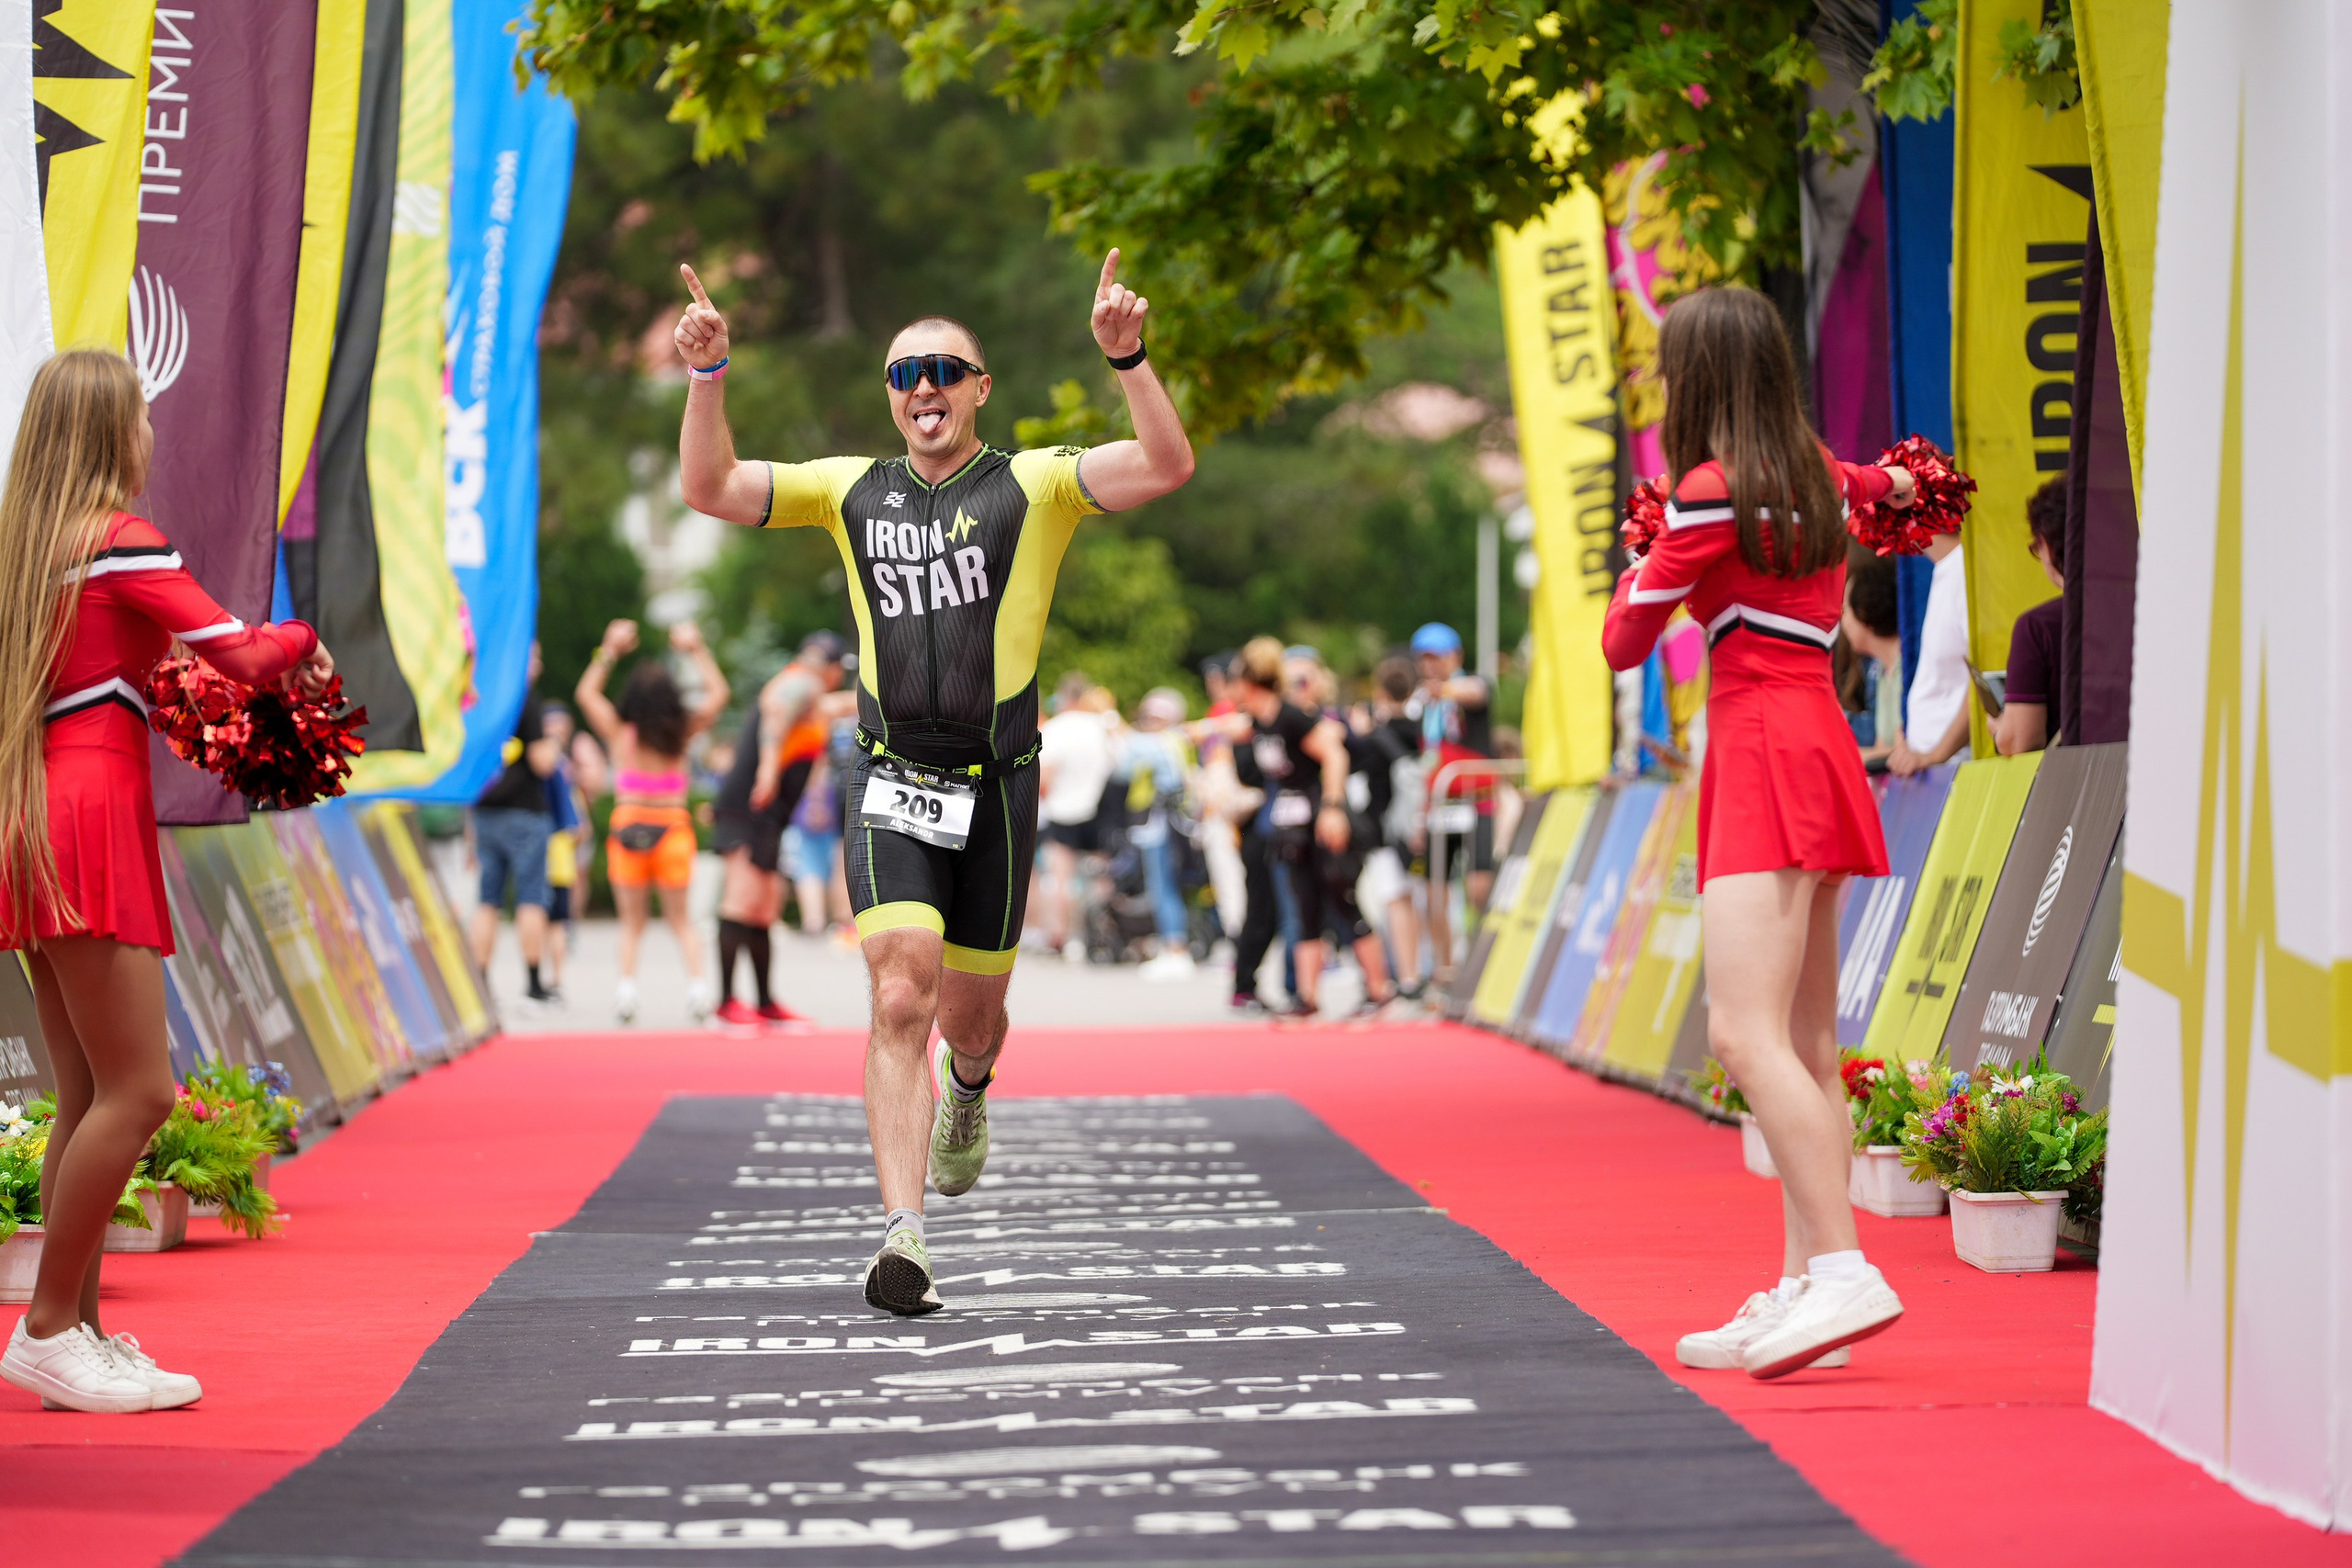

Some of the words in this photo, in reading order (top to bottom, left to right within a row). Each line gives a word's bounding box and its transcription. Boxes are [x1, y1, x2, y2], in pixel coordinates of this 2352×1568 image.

[1541, 239, 1597, 386] STAR
[866, 519, 945, 561] IRON
[873, 546, 989, 617] STAR
[905, 769, 918, 778] IRON
[923, 773, 939, 783] STAR
[890, 790, 943, 824] 209
[890, 818, 934, 839] ALEKSANDR
[663, 1273, 865, 1287] IRO
[1068, 1261, 1347, 1277] STAR
[628, 1336, 927, 1352] IRON
[1088, 1321, 1407, 1341] STAR
[1109, 1397, 1476, 1421] STAR
[1133, 1504, 1577, 1534] STAR
